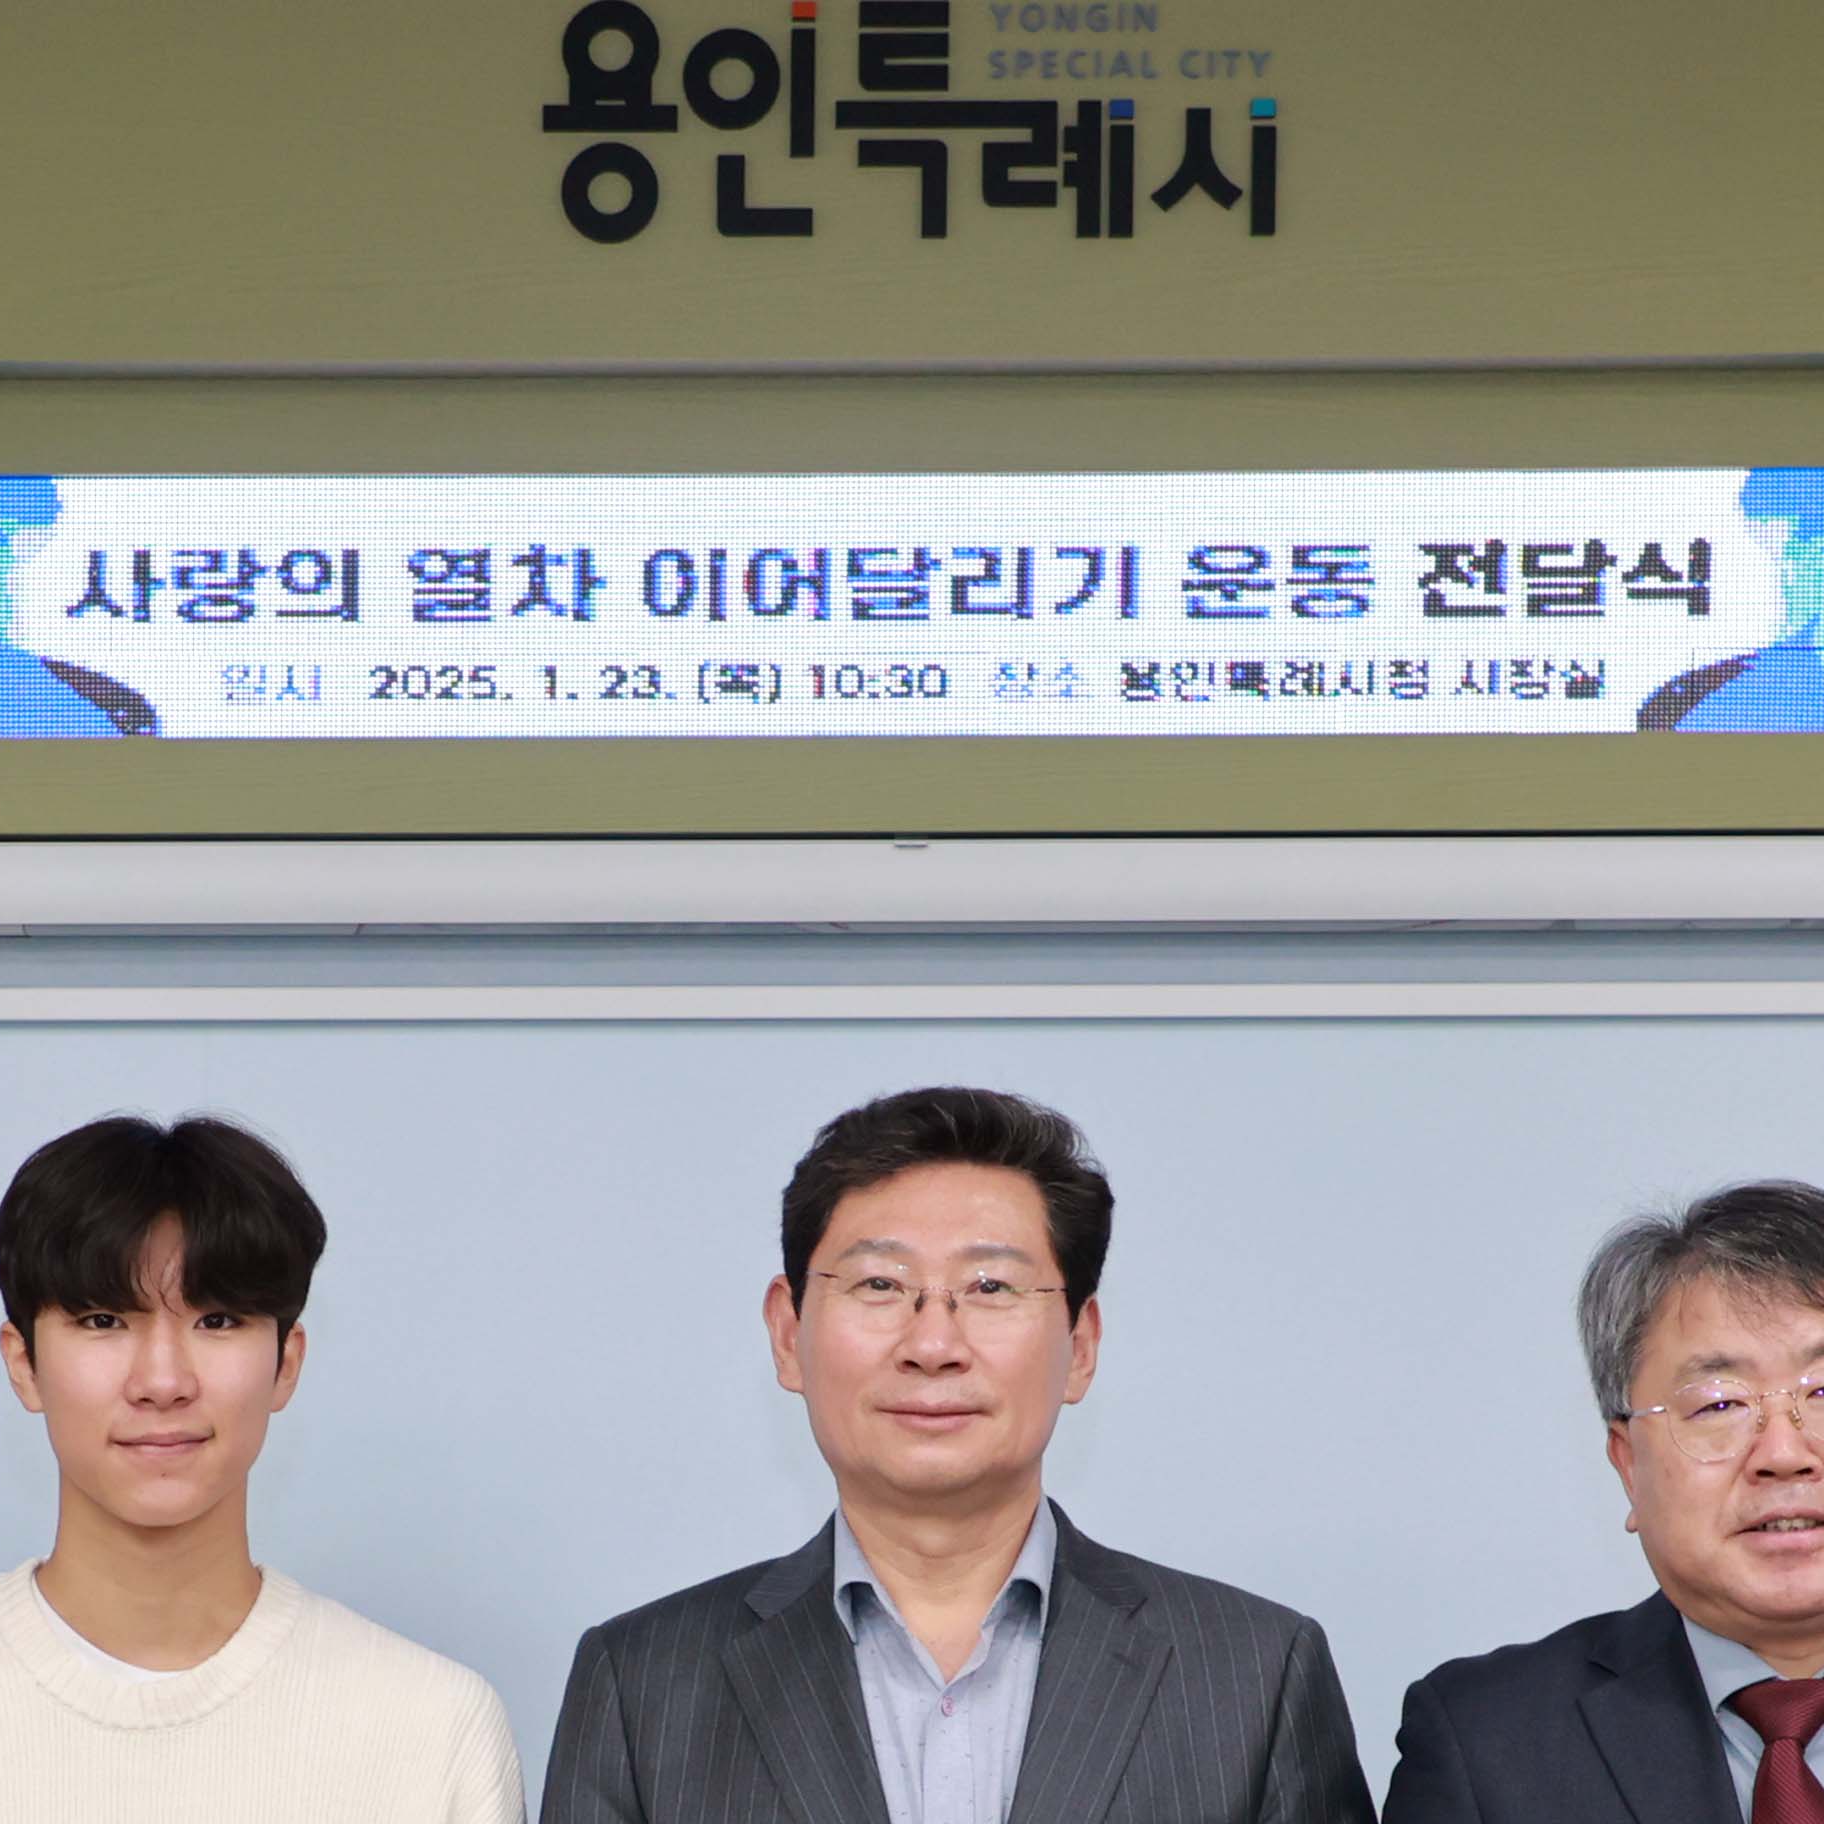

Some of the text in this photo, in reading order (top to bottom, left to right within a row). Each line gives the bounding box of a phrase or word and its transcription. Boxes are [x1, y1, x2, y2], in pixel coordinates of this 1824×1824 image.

[993, 4, 1160, 32] YONGIN
[988, 49, 1272, 79] SPECIAL CITY
[543, 0, 1276, 243] 용인특례시
[67, 538, 1711, 623] 사랑의 열차 이어달리기 운동 전달식
[369, 665, 513, 702] 2025.
[545, 665, 578, 702] 1.
[600, 665, 675, 702] 23.
[809, 663, 949, 701] 10:30
